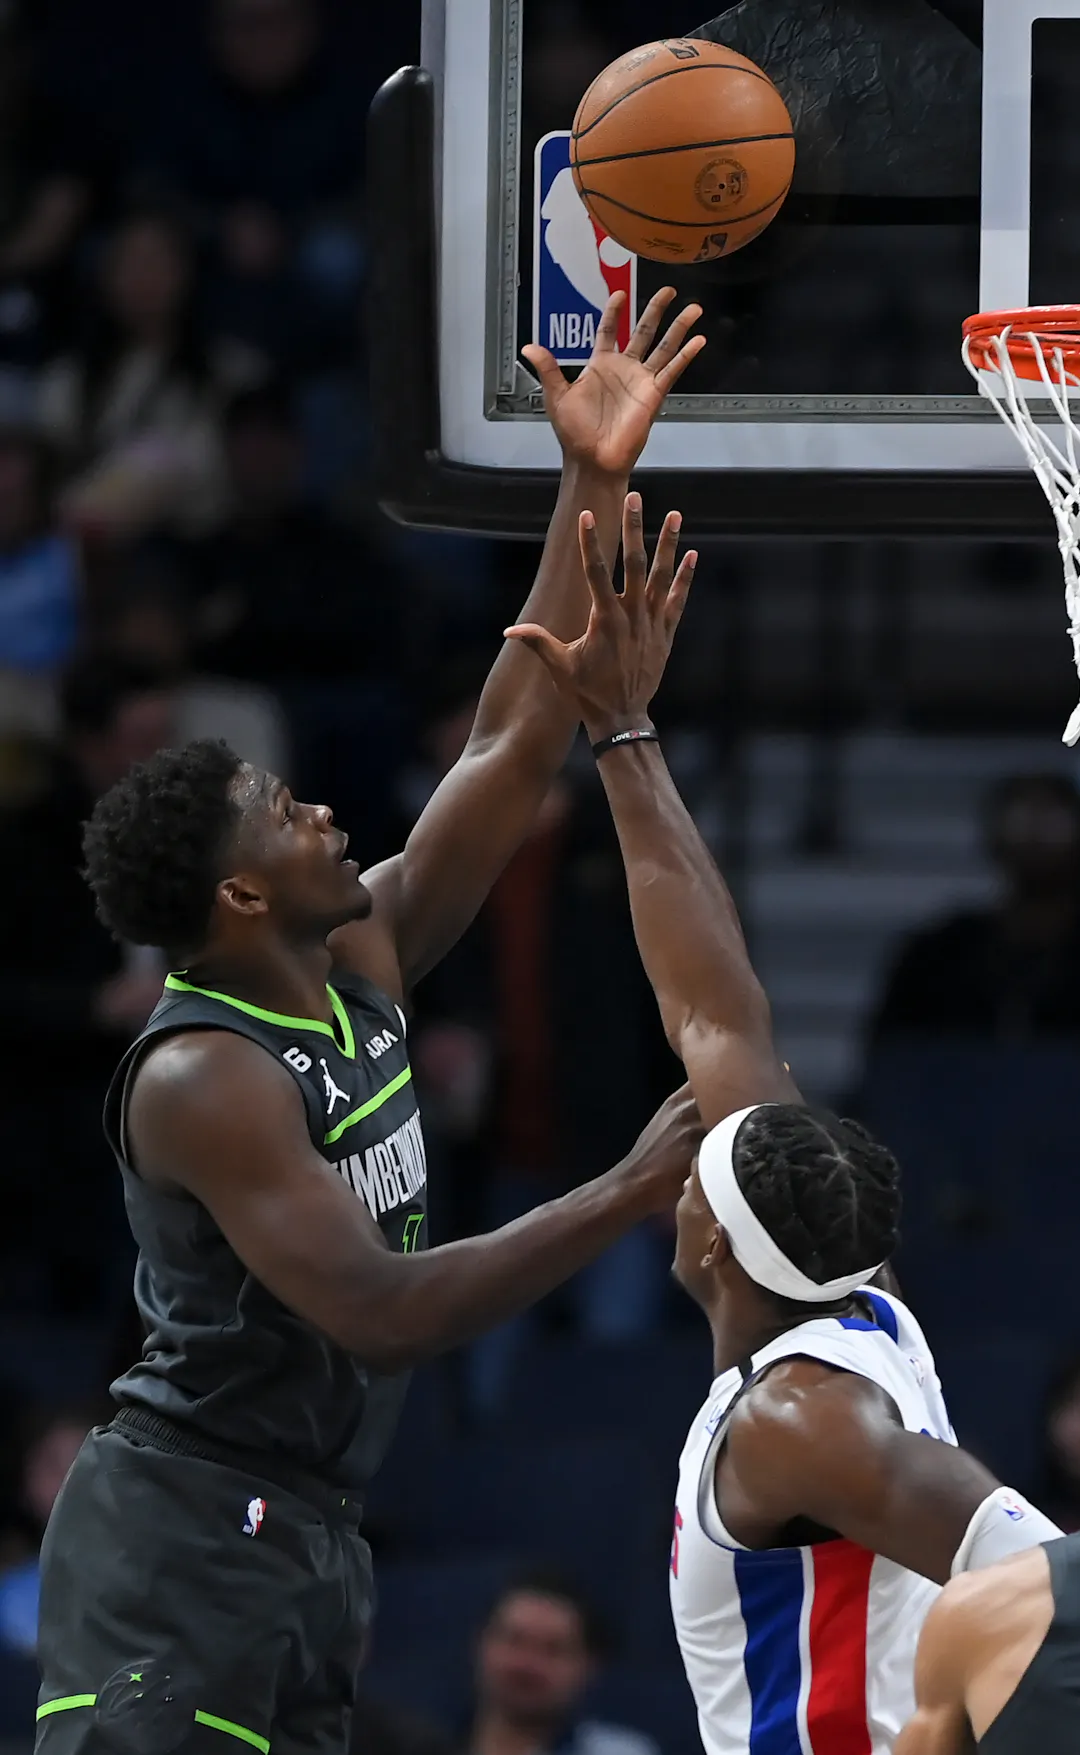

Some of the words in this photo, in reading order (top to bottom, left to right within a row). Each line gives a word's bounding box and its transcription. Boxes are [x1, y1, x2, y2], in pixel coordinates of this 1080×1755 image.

[549, 313, 596, 349] NBA
[611, 732, 631, 743] LOVE
[283, 1047, 312, 1073] 6
